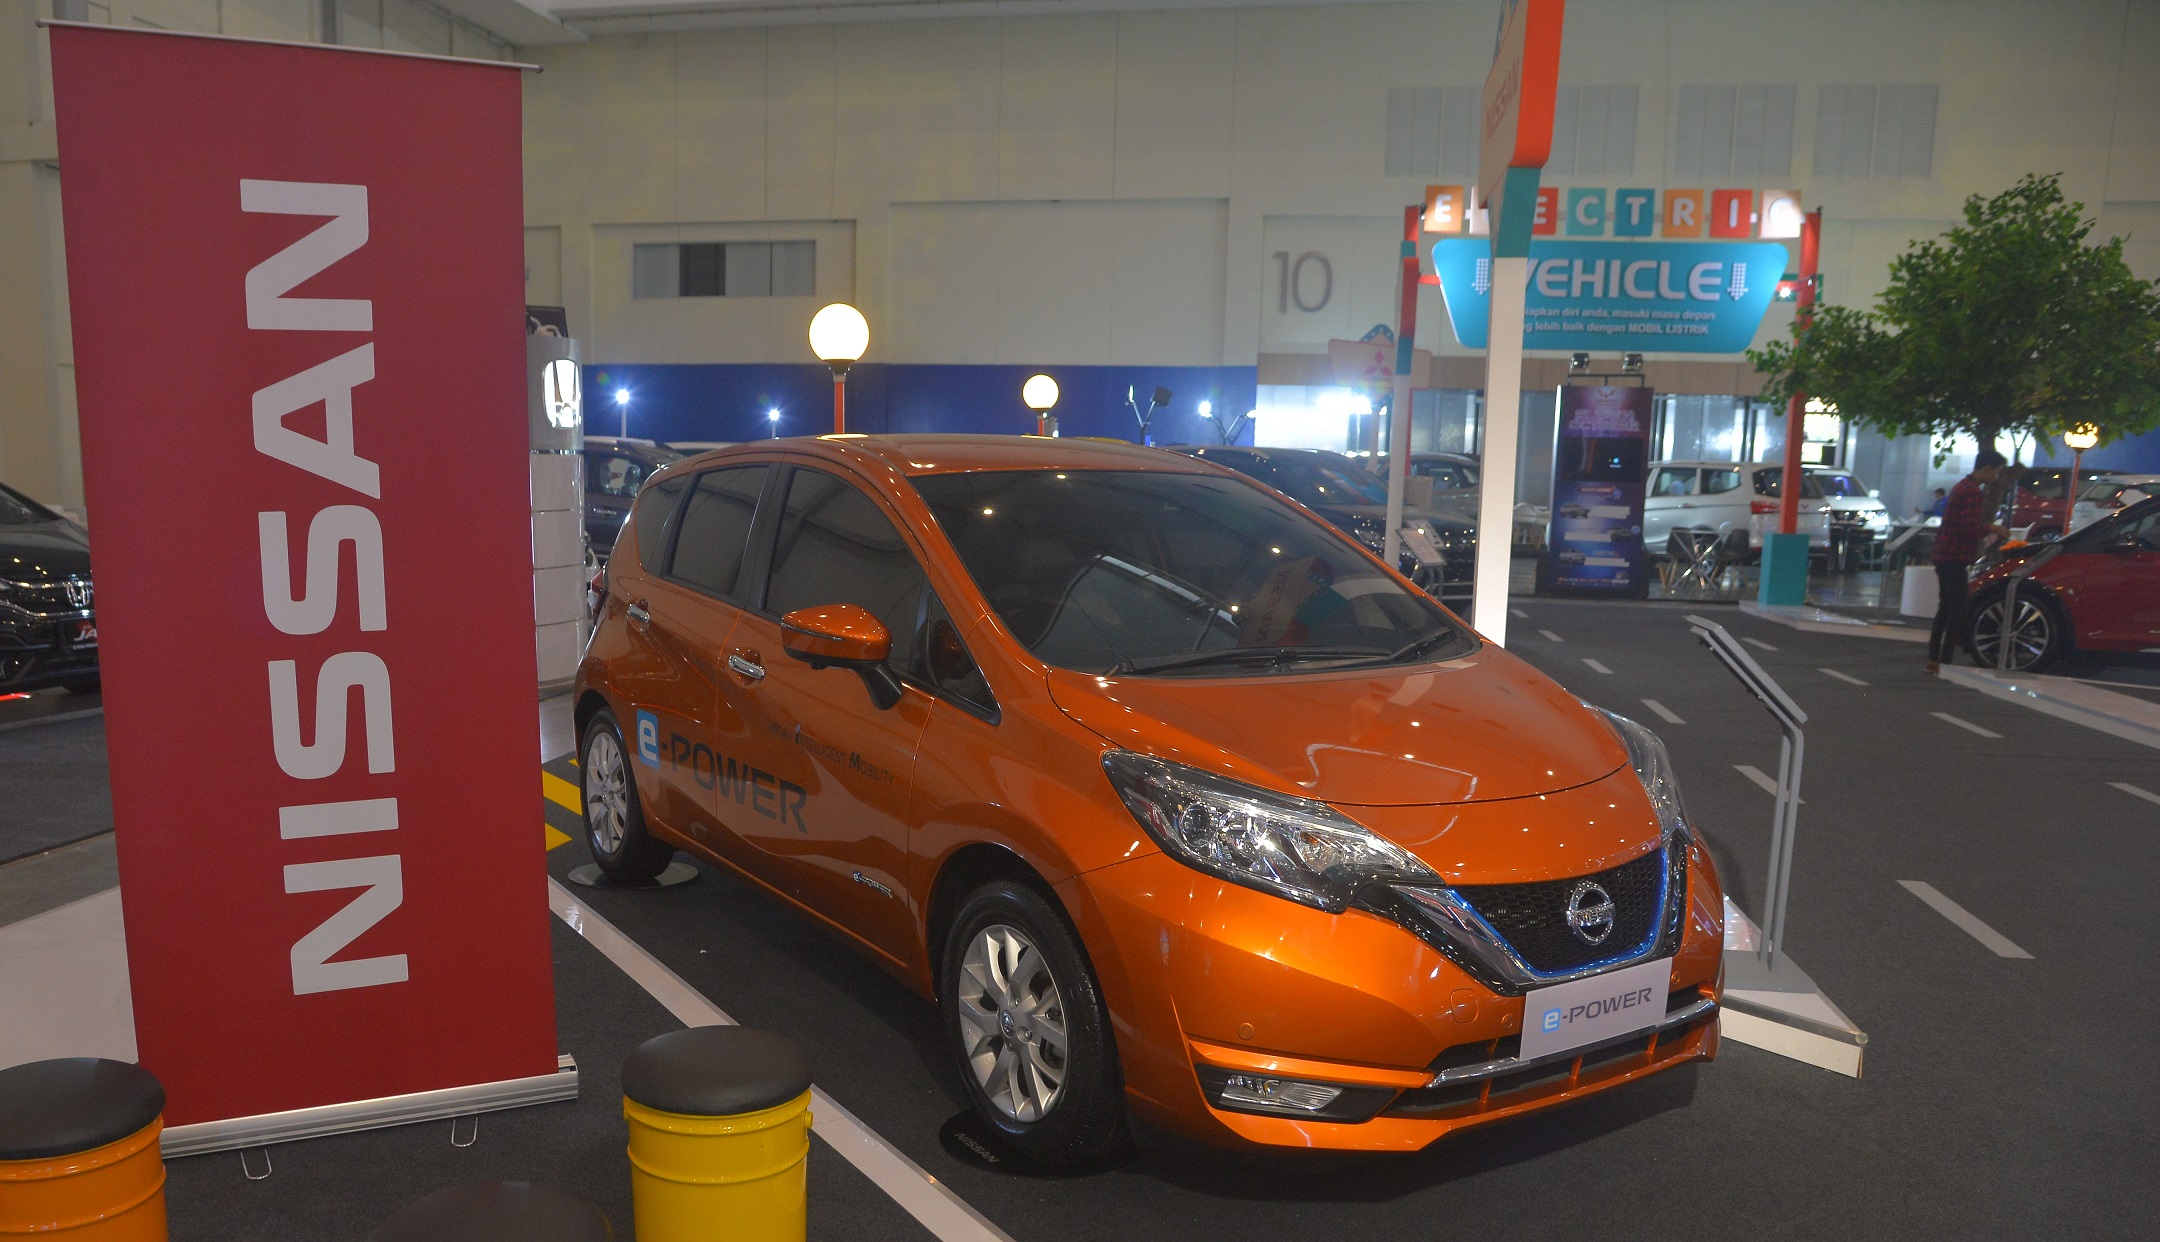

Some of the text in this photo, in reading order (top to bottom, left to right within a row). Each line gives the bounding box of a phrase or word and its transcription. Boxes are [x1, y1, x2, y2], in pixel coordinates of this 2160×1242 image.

[1434, 193, 1796, 228] EECTRIC
[1272, 250, 1333, 314] 10
[1525, 306, 1560, 318] iapkan
[1562, 306, 1580, 317] diri
[1612, 308, 1649, 319] masuki
[1652, 310, 1680, 320] masa
[1682, 310, 1715, 321] depan
[1535, 321, 1561, 332] lebih
[1562, 321, 1584, 332] baik
[1586, 322, 1626, 335] dengan
[1628, 322, 1663, 334] MOBIL
[1665, 323, 1709, 335] LISTRIK
[240, 178, 409, 996] NISSAN
[73, 628, 97, 642] JA
[638, 715, 808, 834] e-POWER
[849, 751, 895, 785] MOBILITY
[1543, 987, 1653, 1032] e-POWER
[954, 1133, 999, 1163] NISSAN
